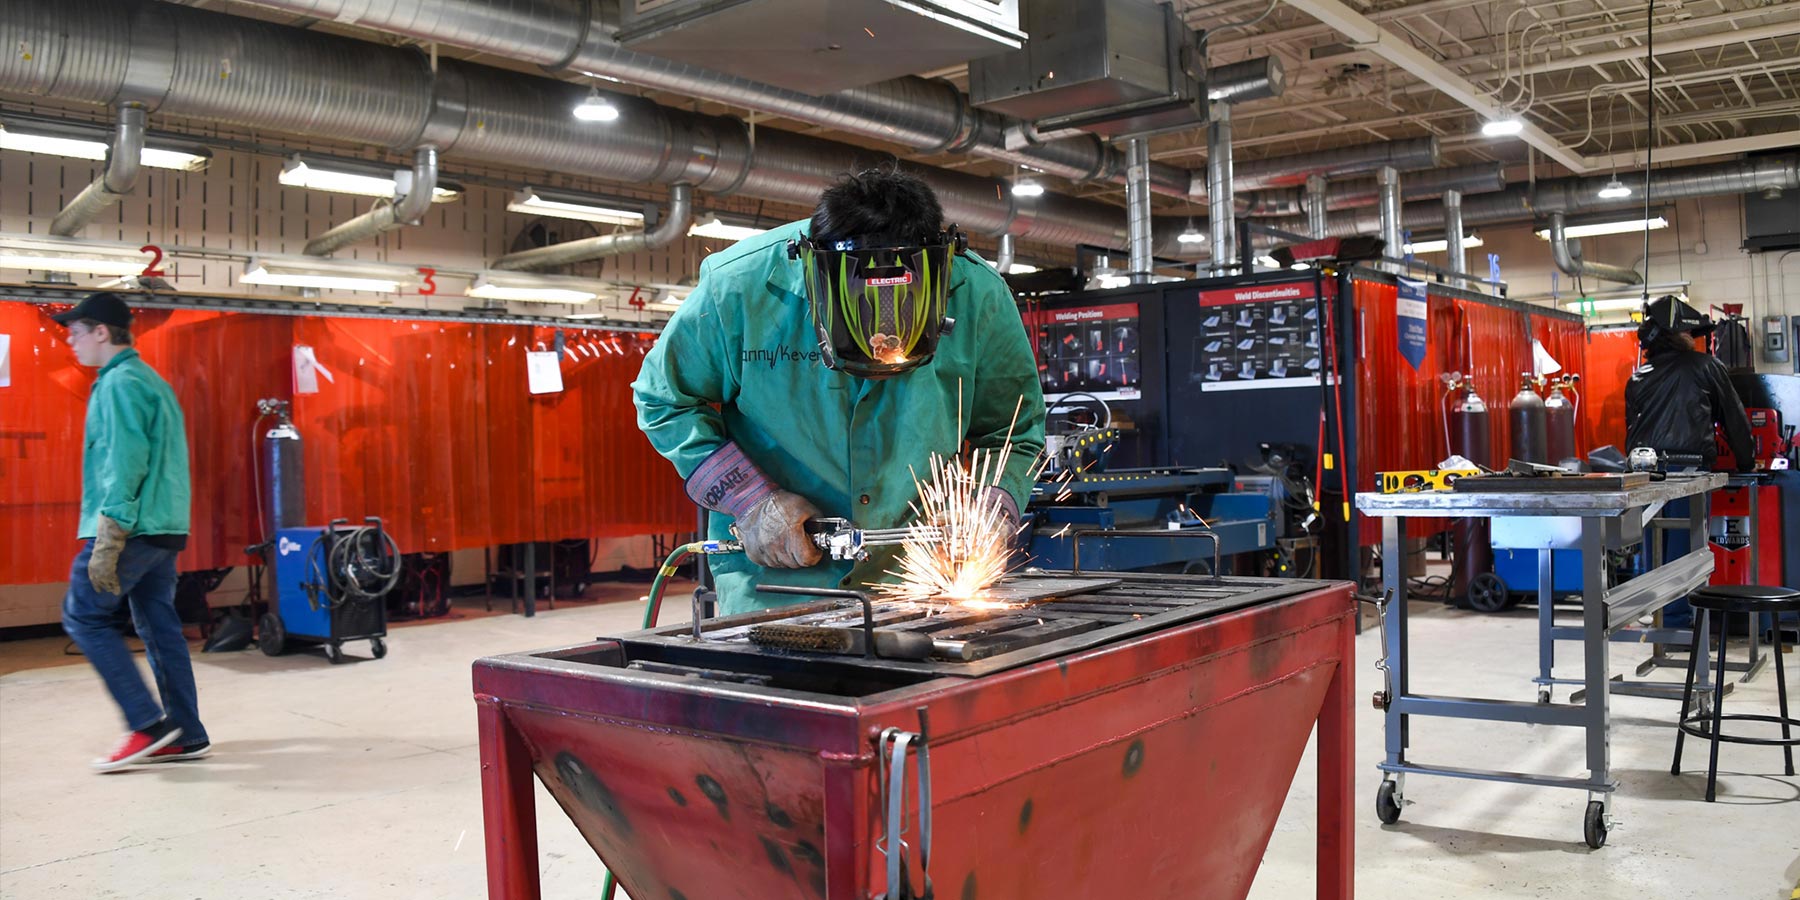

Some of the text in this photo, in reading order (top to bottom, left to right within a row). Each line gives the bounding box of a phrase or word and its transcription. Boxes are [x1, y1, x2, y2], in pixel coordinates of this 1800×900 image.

[139, 245, 165, 276] 2
[1487, 253, 1501, 283] 16
[418, 267, 437, 295] 3
[871, 276, 908, 285] ELECTRIC
[628, 286, 646, 311] 4
[1234, 287, 1300, 301] Weld Discontinuities
[1055, 310, 1104, 321] Welding Positions
[1725, 519, 1741, 534] E
[1715, 536, 1750, 545] EDWARDS
